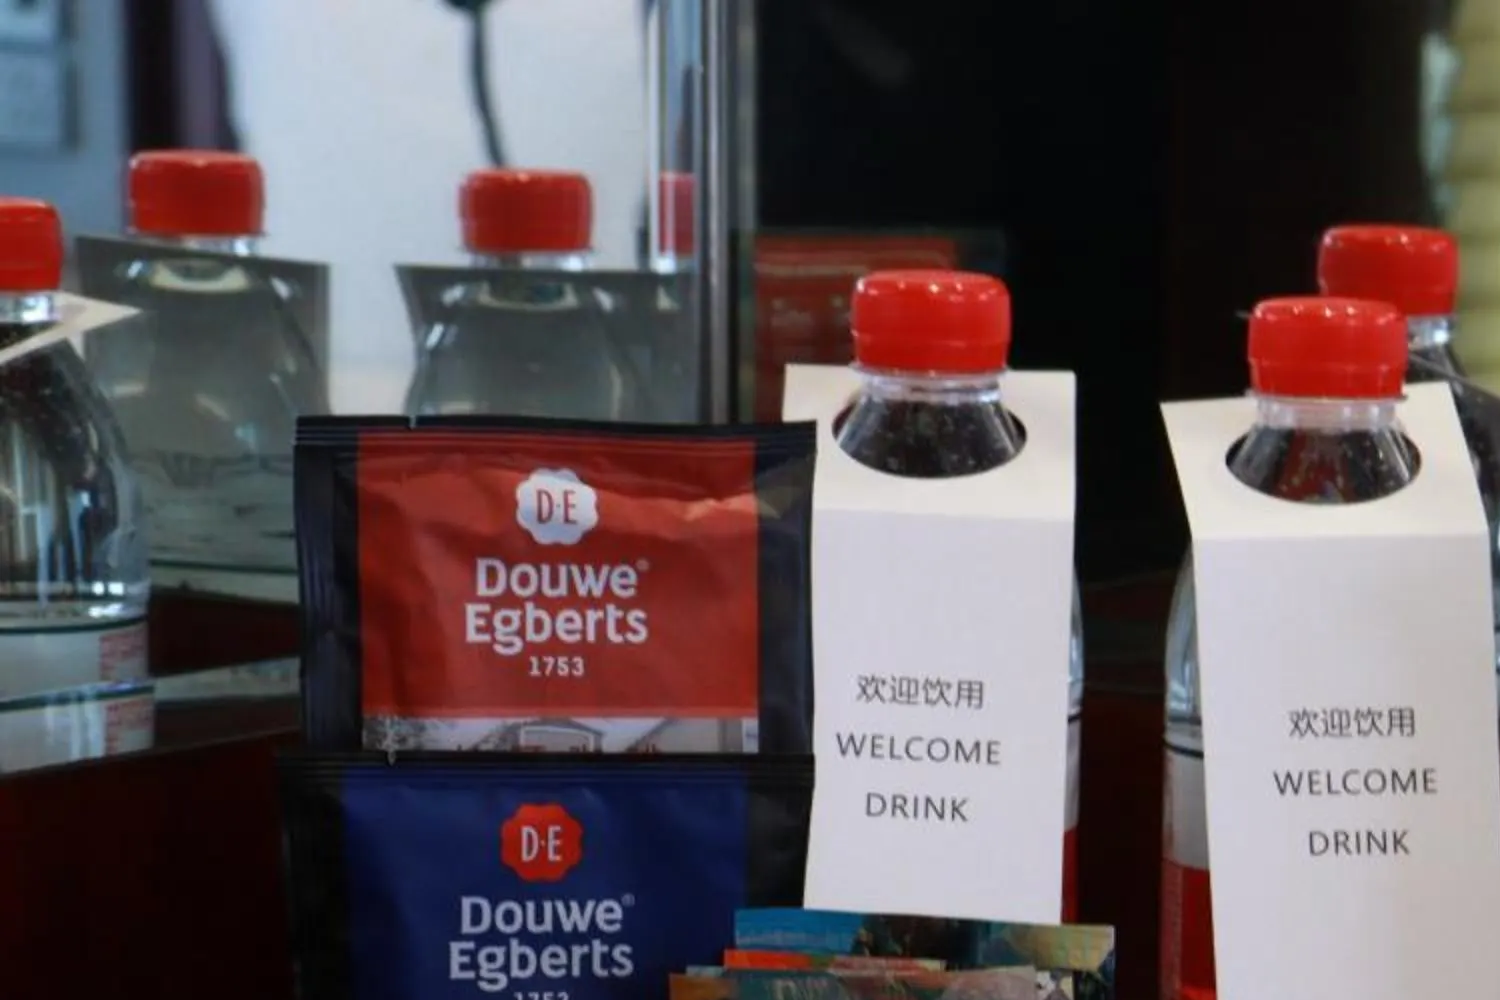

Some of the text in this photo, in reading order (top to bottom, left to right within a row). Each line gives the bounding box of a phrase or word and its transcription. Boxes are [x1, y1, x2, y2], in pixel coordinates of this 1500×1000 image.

[475, 557, 637, 598] Douwe
[464, 603, 648, 655] Egberts
[528, 656, 585, 677] 1753
[856, 673, 985, 710] 欢迎饮用
[1288, 706, 1416, 739] 欢迎饮用
[836, 732, 1001, 765] WELCOME
[1273, 767, 1438, 797] WELCOME
[865, 791, 969, 822] DRINK
[1308, 829, 1410, 857] DRINK
[460, 895, 623, 935] Douwe
[449, 938, 635, 991] Egberts
